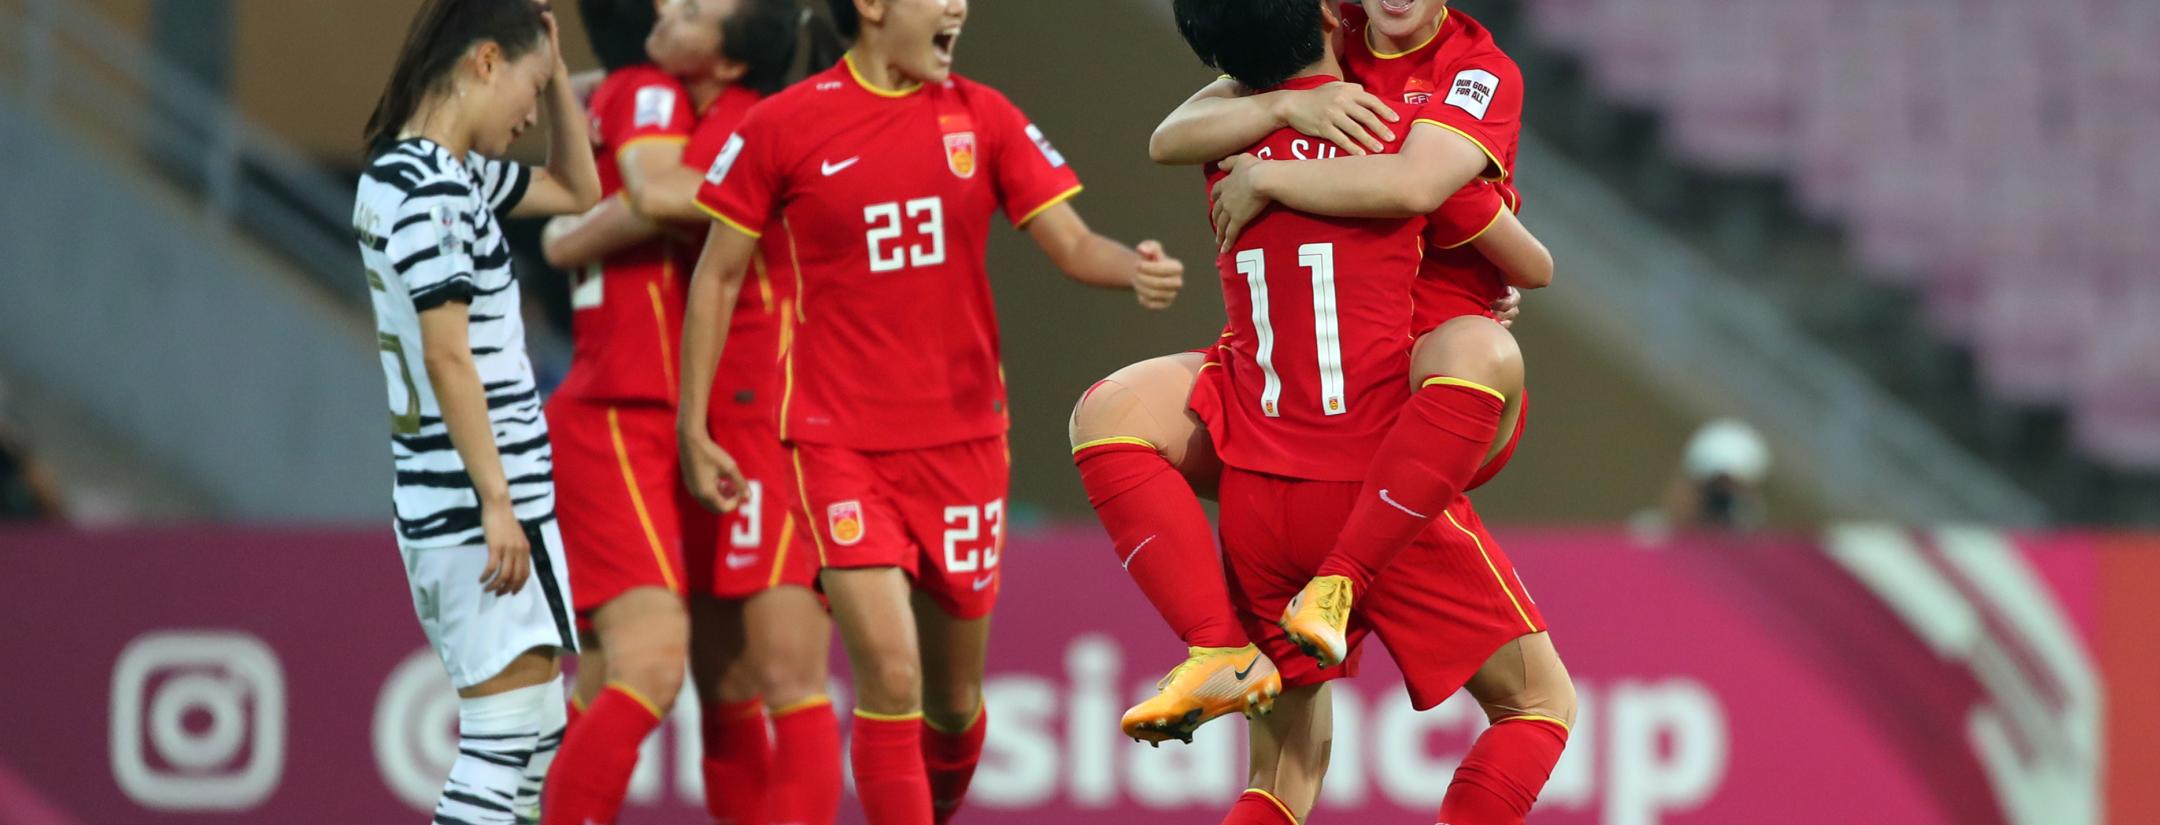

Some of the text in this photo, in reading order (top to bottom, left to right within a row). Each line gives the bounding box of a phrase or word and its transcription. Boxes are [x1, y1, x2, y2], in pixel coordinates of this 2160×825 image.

[1455, 87, 1484, 104] FOR ALL
[1456, 79, 1491, 97] OUR GOAL
[863, 196, 945, 272] 23
[1236, 242, 1347, 417] 11
[943, 497, 1003, 573] 23
